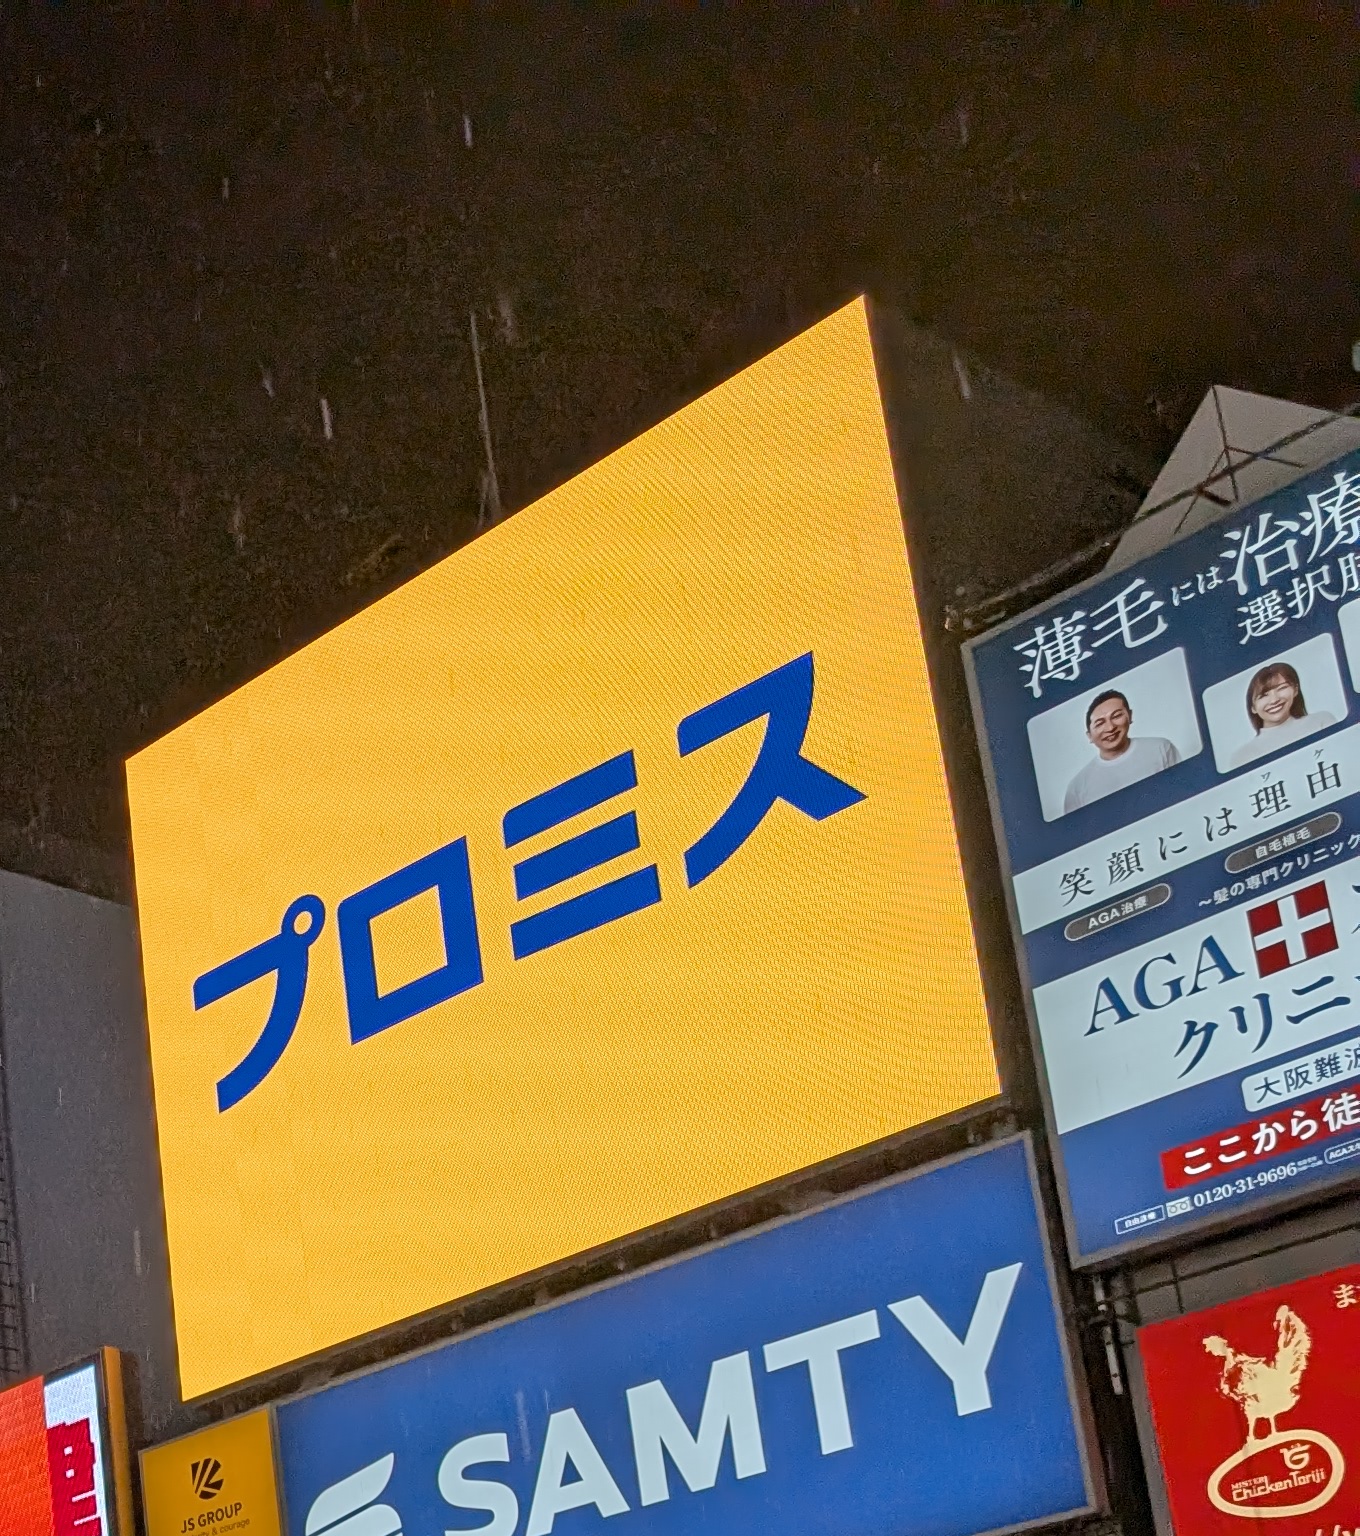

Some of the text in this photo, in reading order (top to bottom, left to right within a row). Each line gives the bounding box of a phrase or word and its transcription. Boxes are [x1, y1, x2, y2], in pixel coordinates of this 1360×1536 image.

[194, 650, 868, 1114] プロミス
[1084, 935, 1245, 1037] AGA
[1174, 974, 1360, 1079] クリニ
[1194, 1161, 1298, 1208] 0120-31-9696
[181, 1502, 243, 1534] JS GROUP
[219, 1517, 251, 1536] courage
